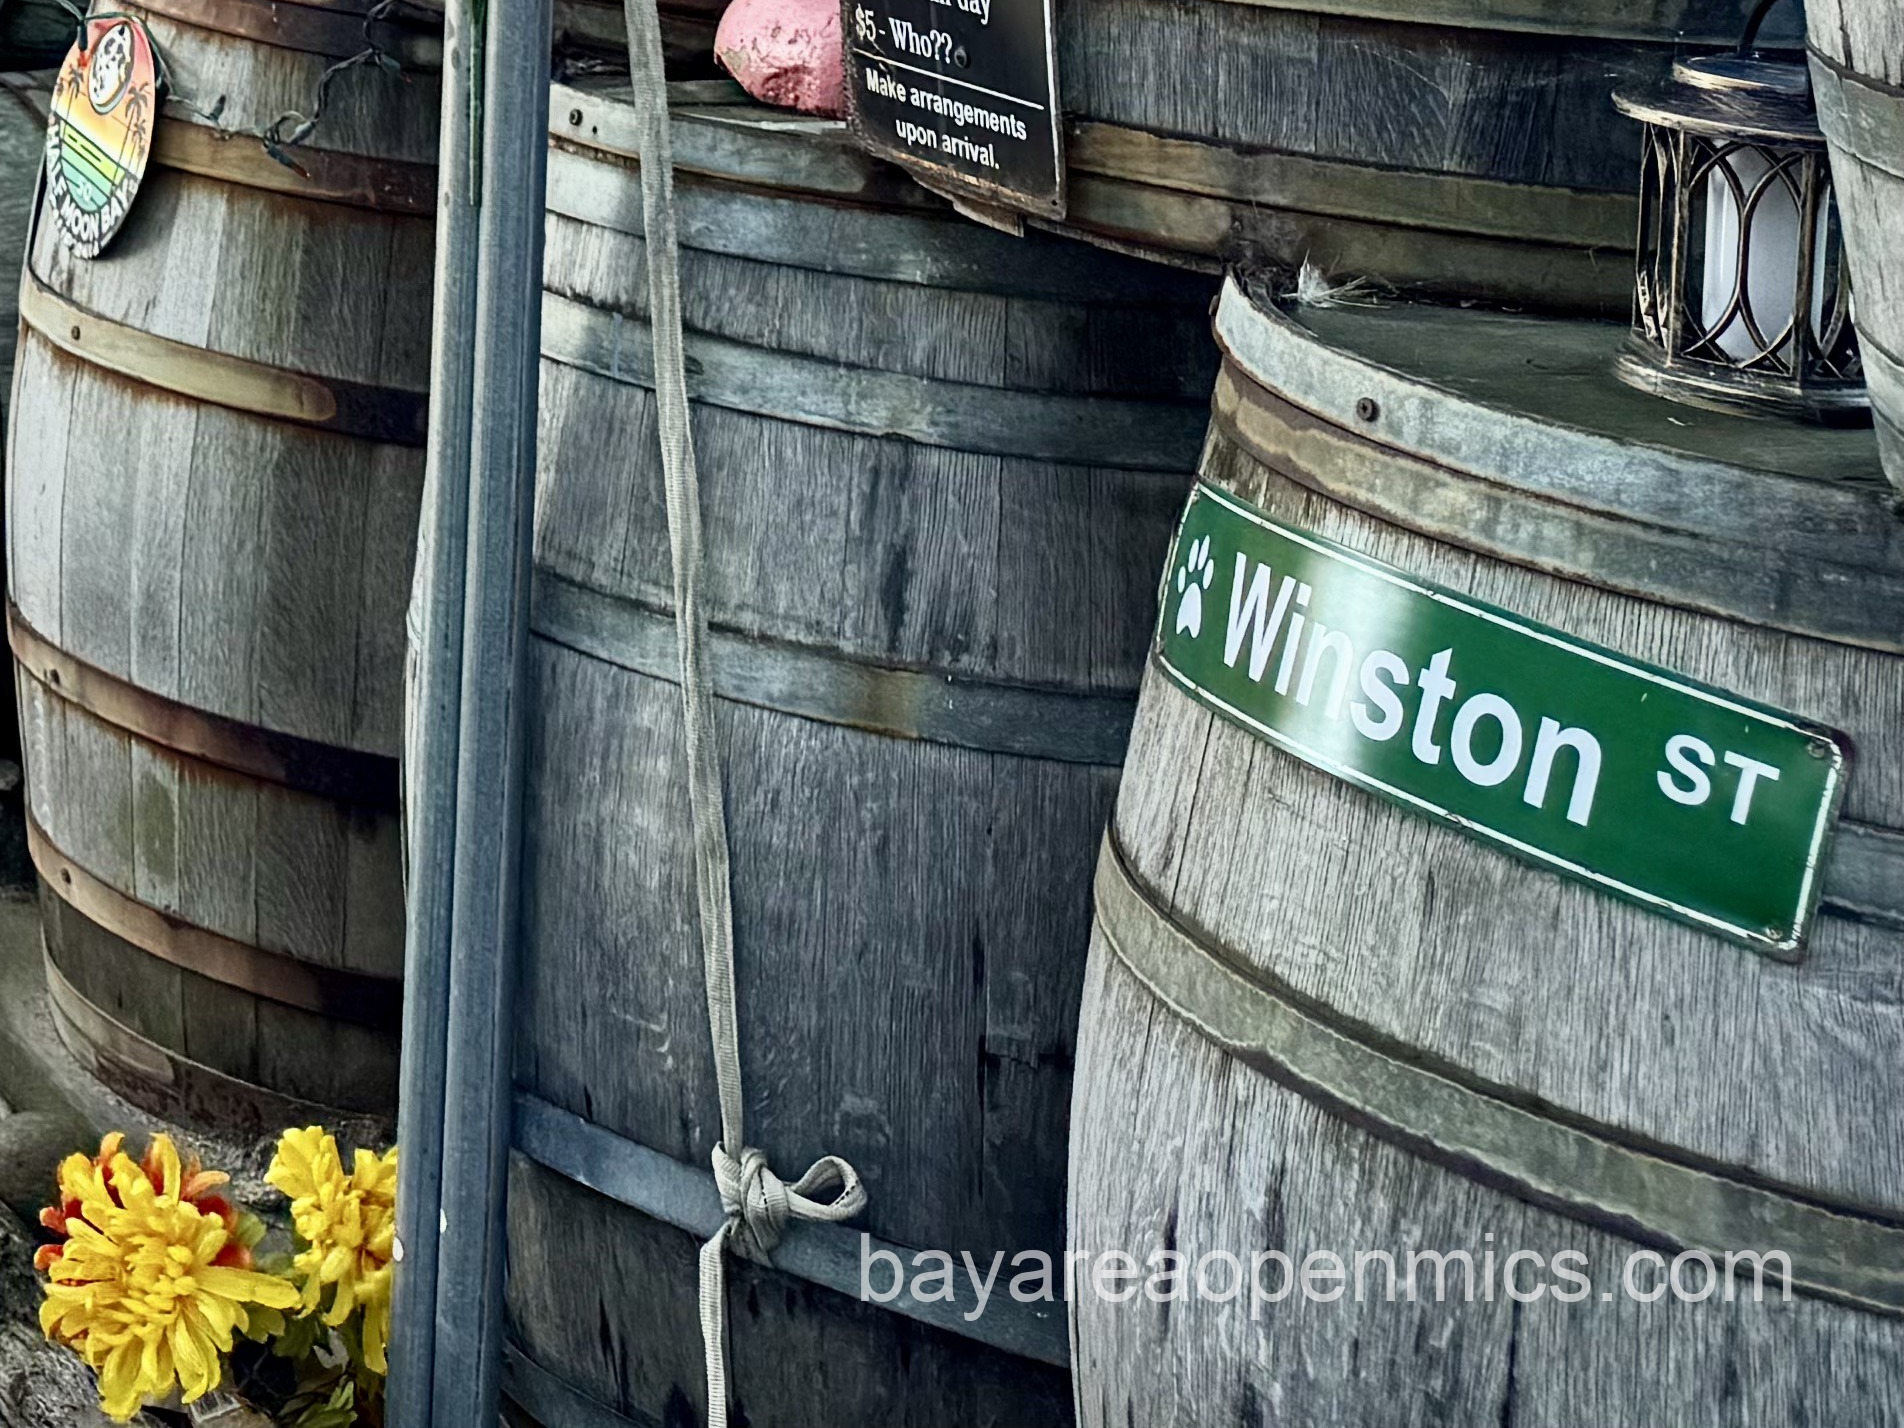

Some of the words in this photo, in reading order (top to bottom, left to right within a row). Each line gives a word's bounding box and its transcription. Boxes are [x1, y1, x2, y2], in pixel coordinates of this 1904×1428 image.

[888, 17, 953, 64] Who??
[866, 67, 907, 102] Make
[910, 87, 1028, 142] arrangements
[896, 118, 938, 149] upon
[941, 131, 1000, 170] arrival.
[61, 195, 101, 242] MOON
[101, 178, 129, 231] BAY
[1223, 550, 1603, 827] Winston
[1656, 733, 1782, 826] ST
